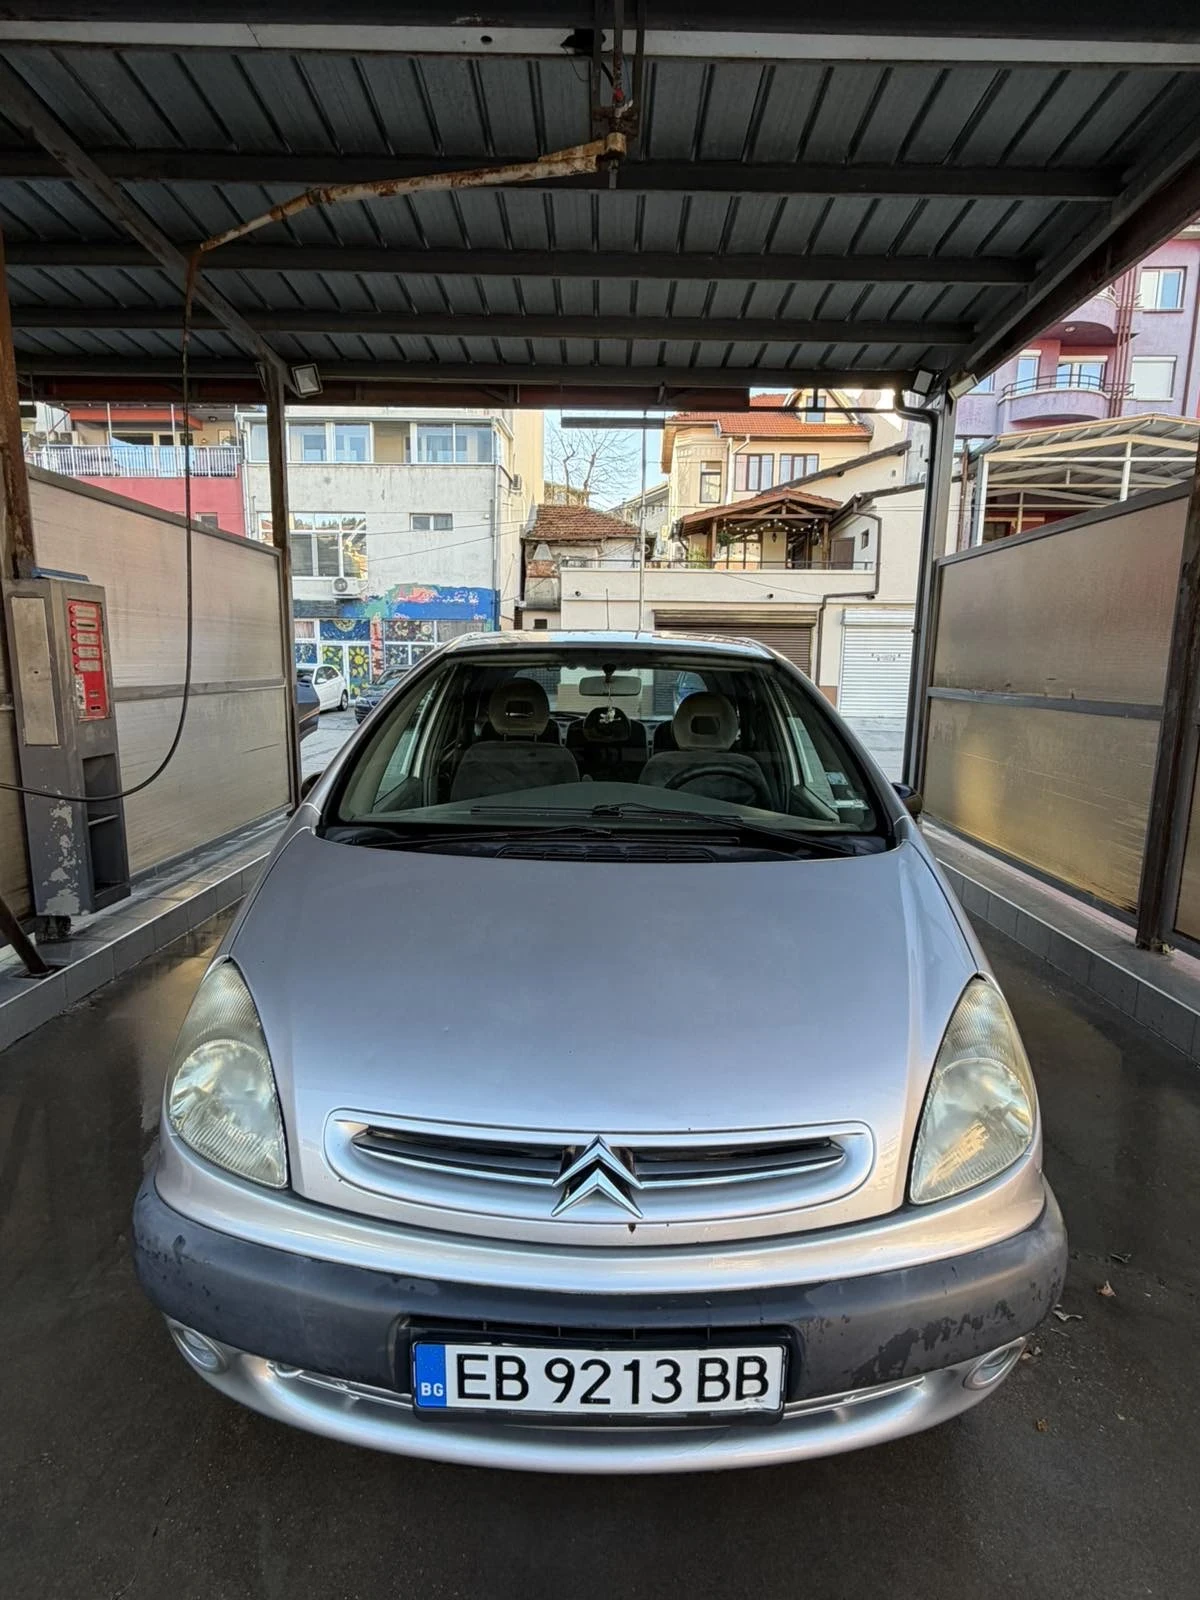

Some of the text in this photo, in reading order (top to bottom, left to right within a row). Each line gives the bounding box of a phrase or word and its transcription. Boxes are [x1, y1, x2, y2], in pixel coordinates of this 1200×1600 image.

[420, 1382, 444, 1397] BG
[456, 1353, 769, 1405] EB 9213 BB
